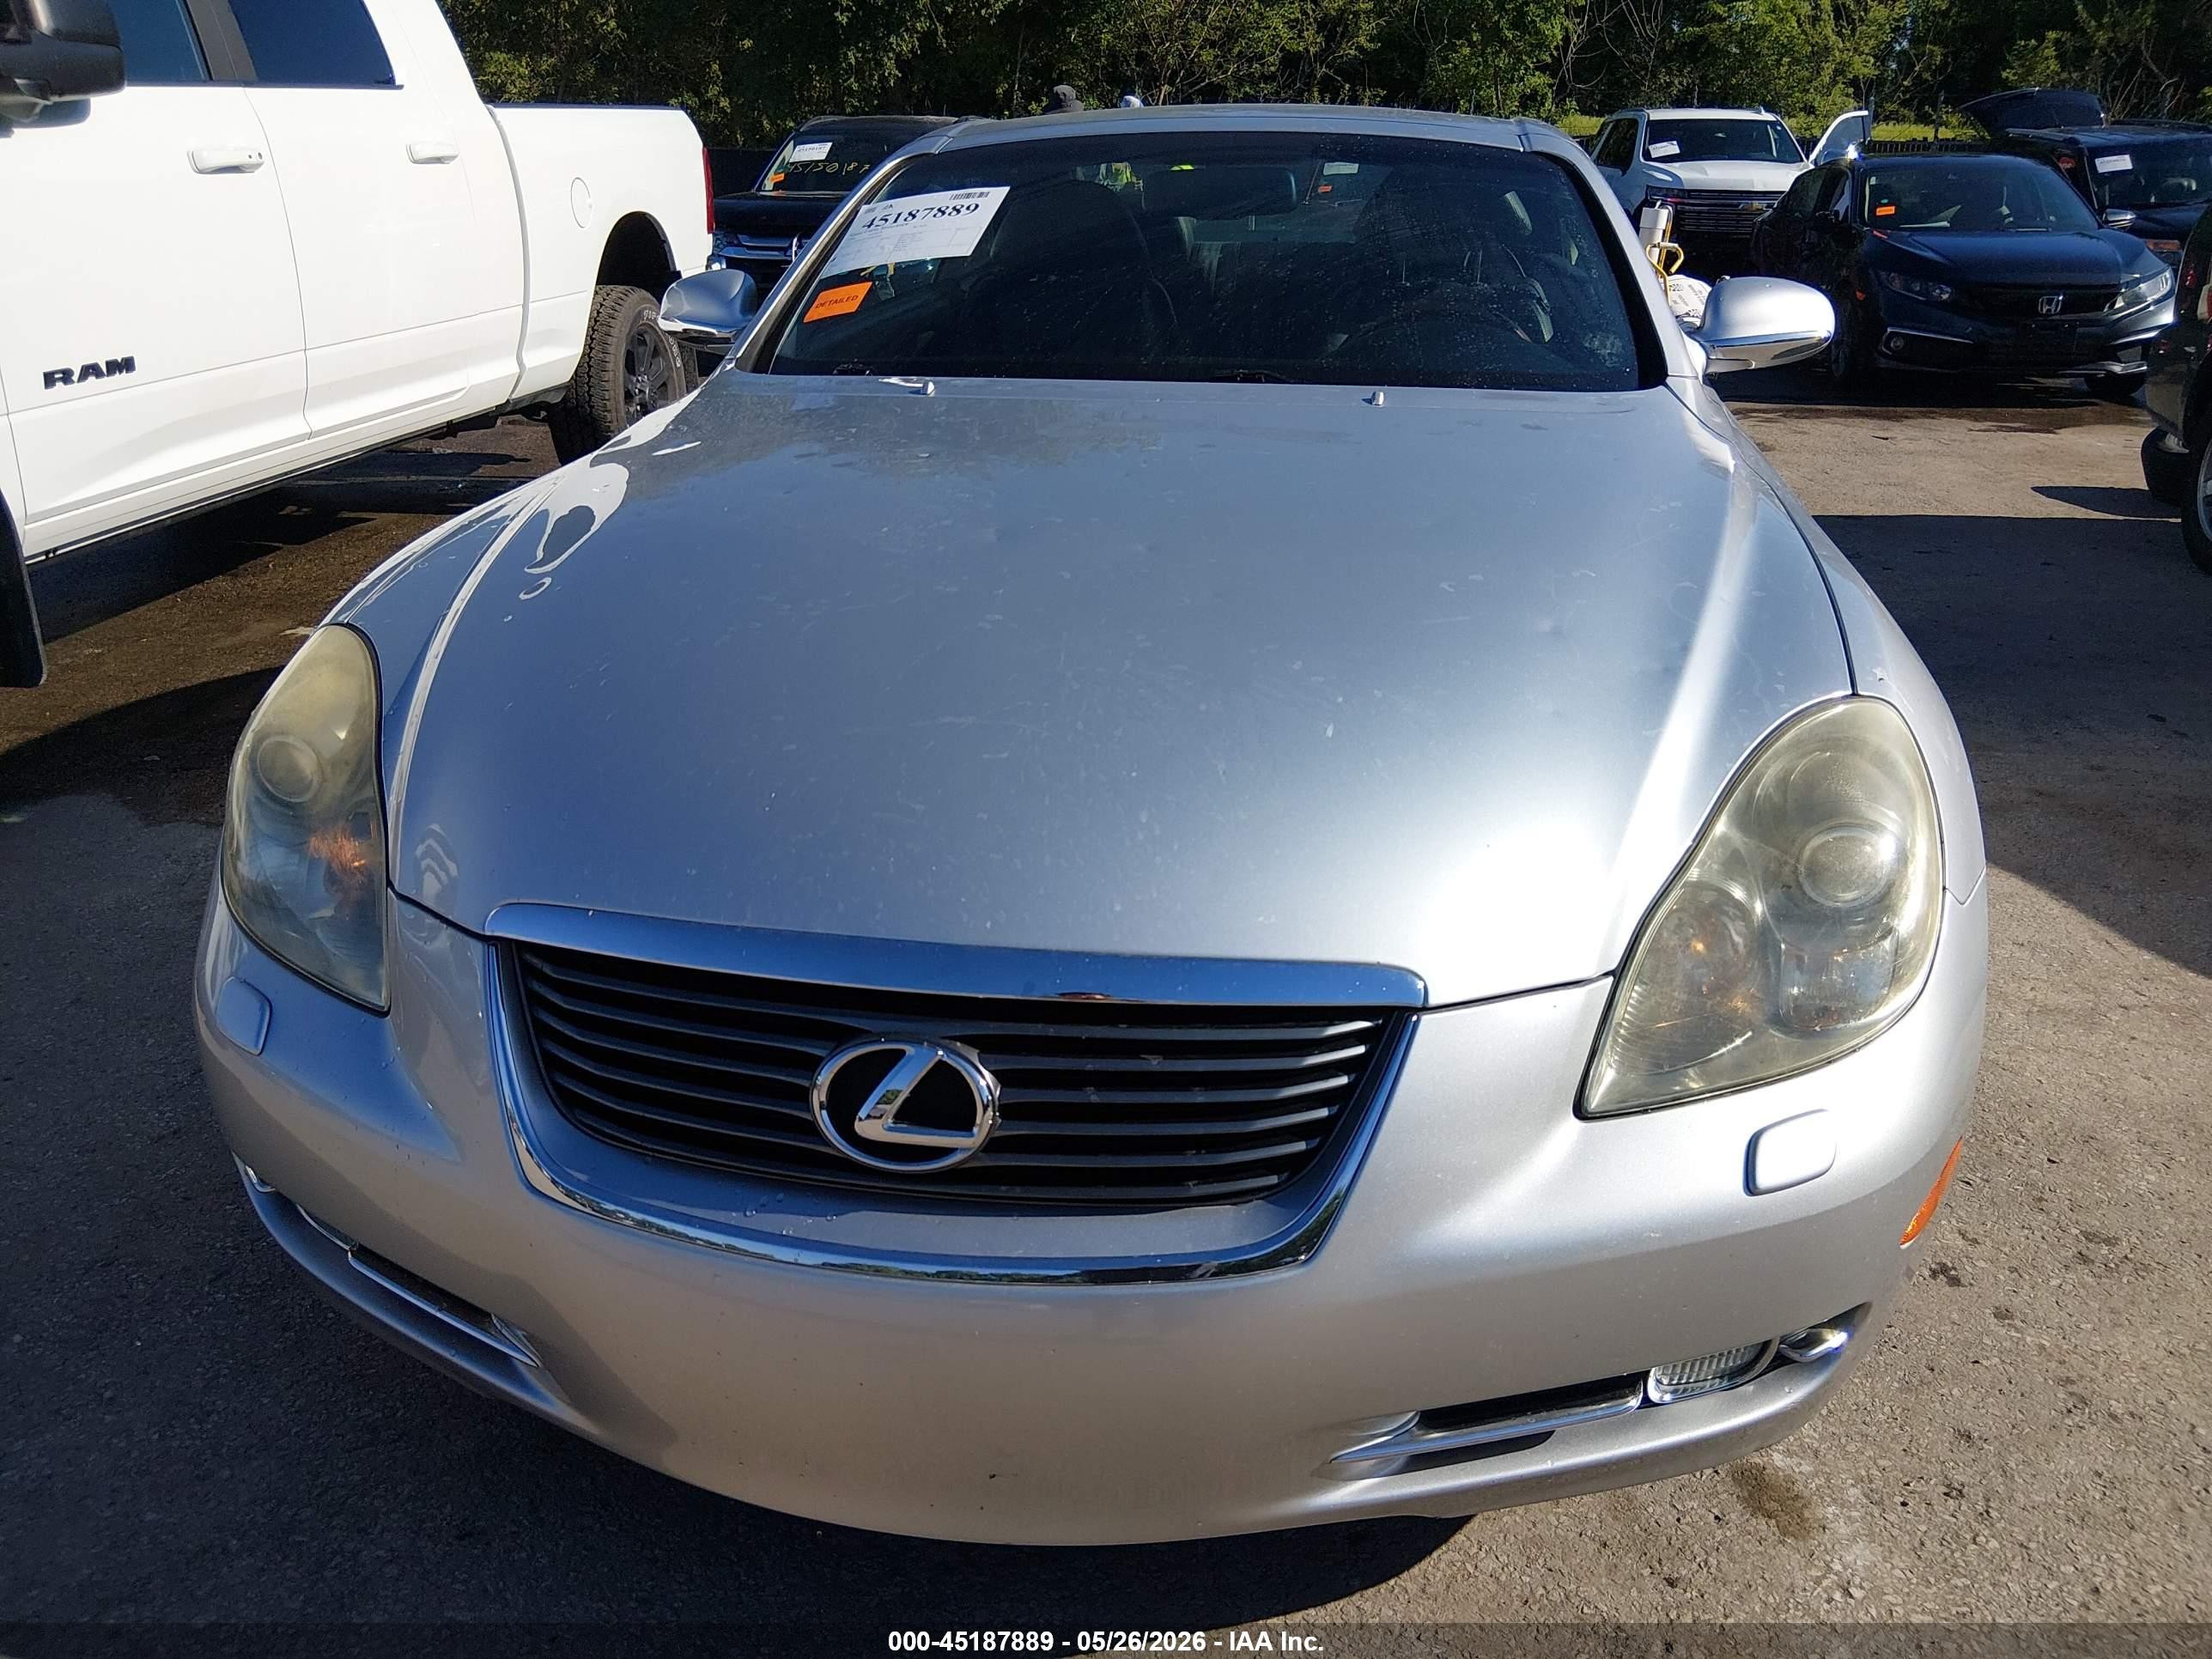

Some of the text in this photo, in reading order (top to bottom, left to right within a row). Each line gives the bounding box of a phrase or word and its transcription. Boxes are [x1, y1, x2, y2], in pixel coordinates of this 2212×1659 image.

[861, 203, 980, 229] 45187889
[815, 295, 859, 309] DETAILED
[43, 356, 136, 390] RAM
